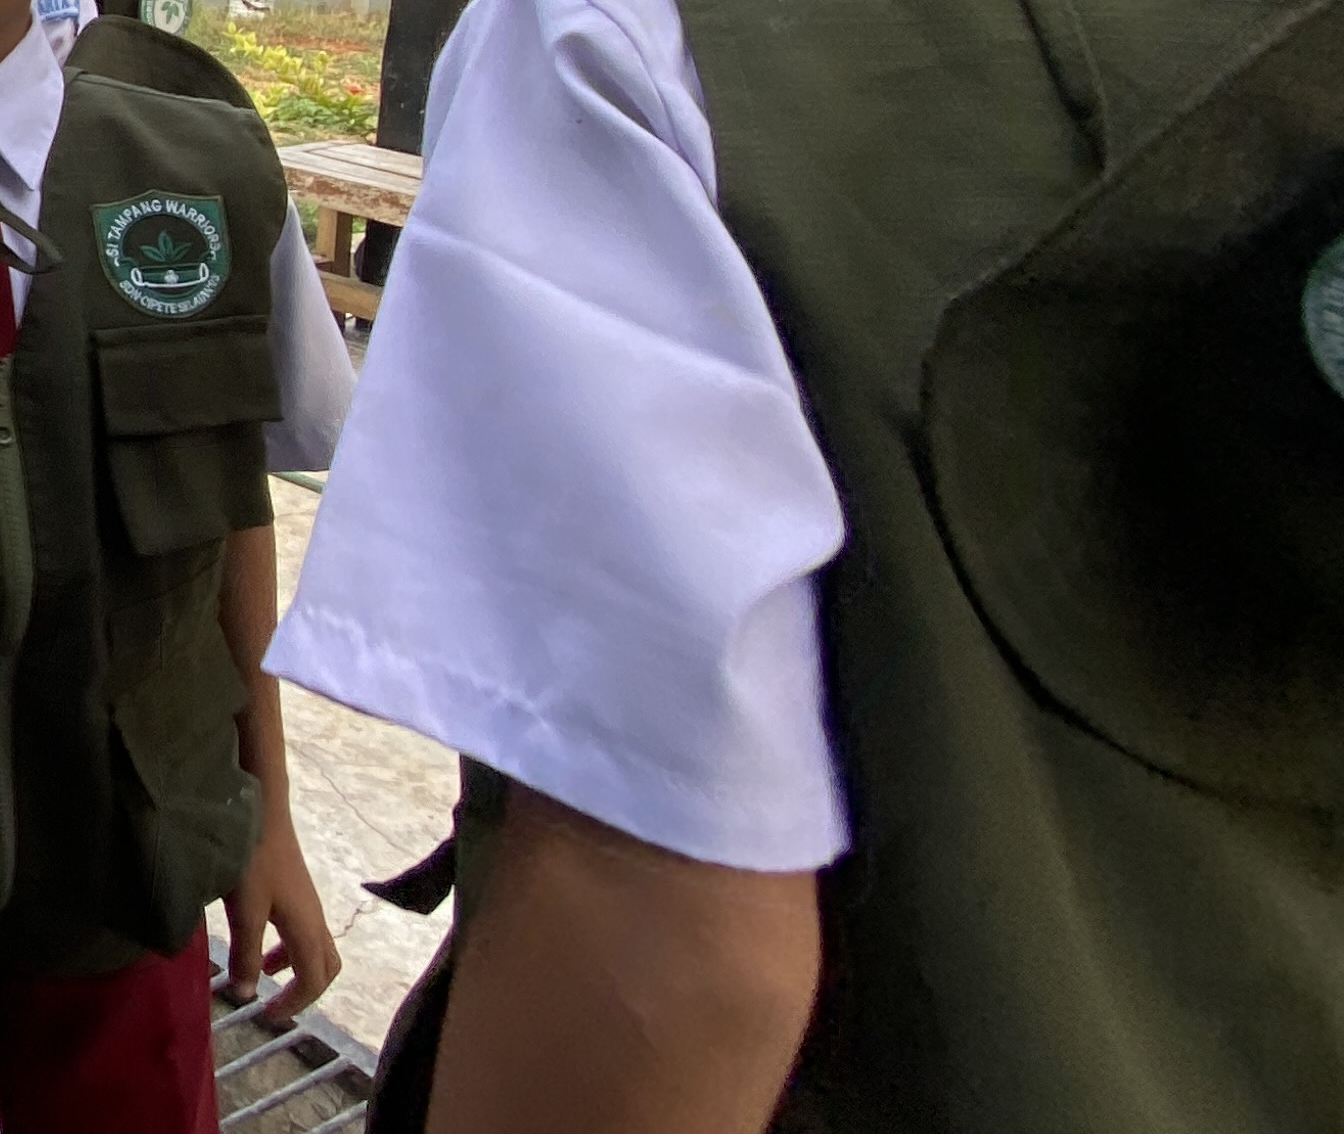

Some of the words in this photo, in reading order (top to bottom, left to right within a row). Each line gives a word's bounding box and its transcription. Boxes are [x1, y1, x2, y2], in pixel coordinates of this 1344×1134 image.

[107, 199, 163, 240] TAMPANG
[165, 199, 221, 252] WARRIORS
[106, 243, 119, 258] SI
[119, 280, 141, 302] SDN
[140, 295, 178, 315] CIPETE
